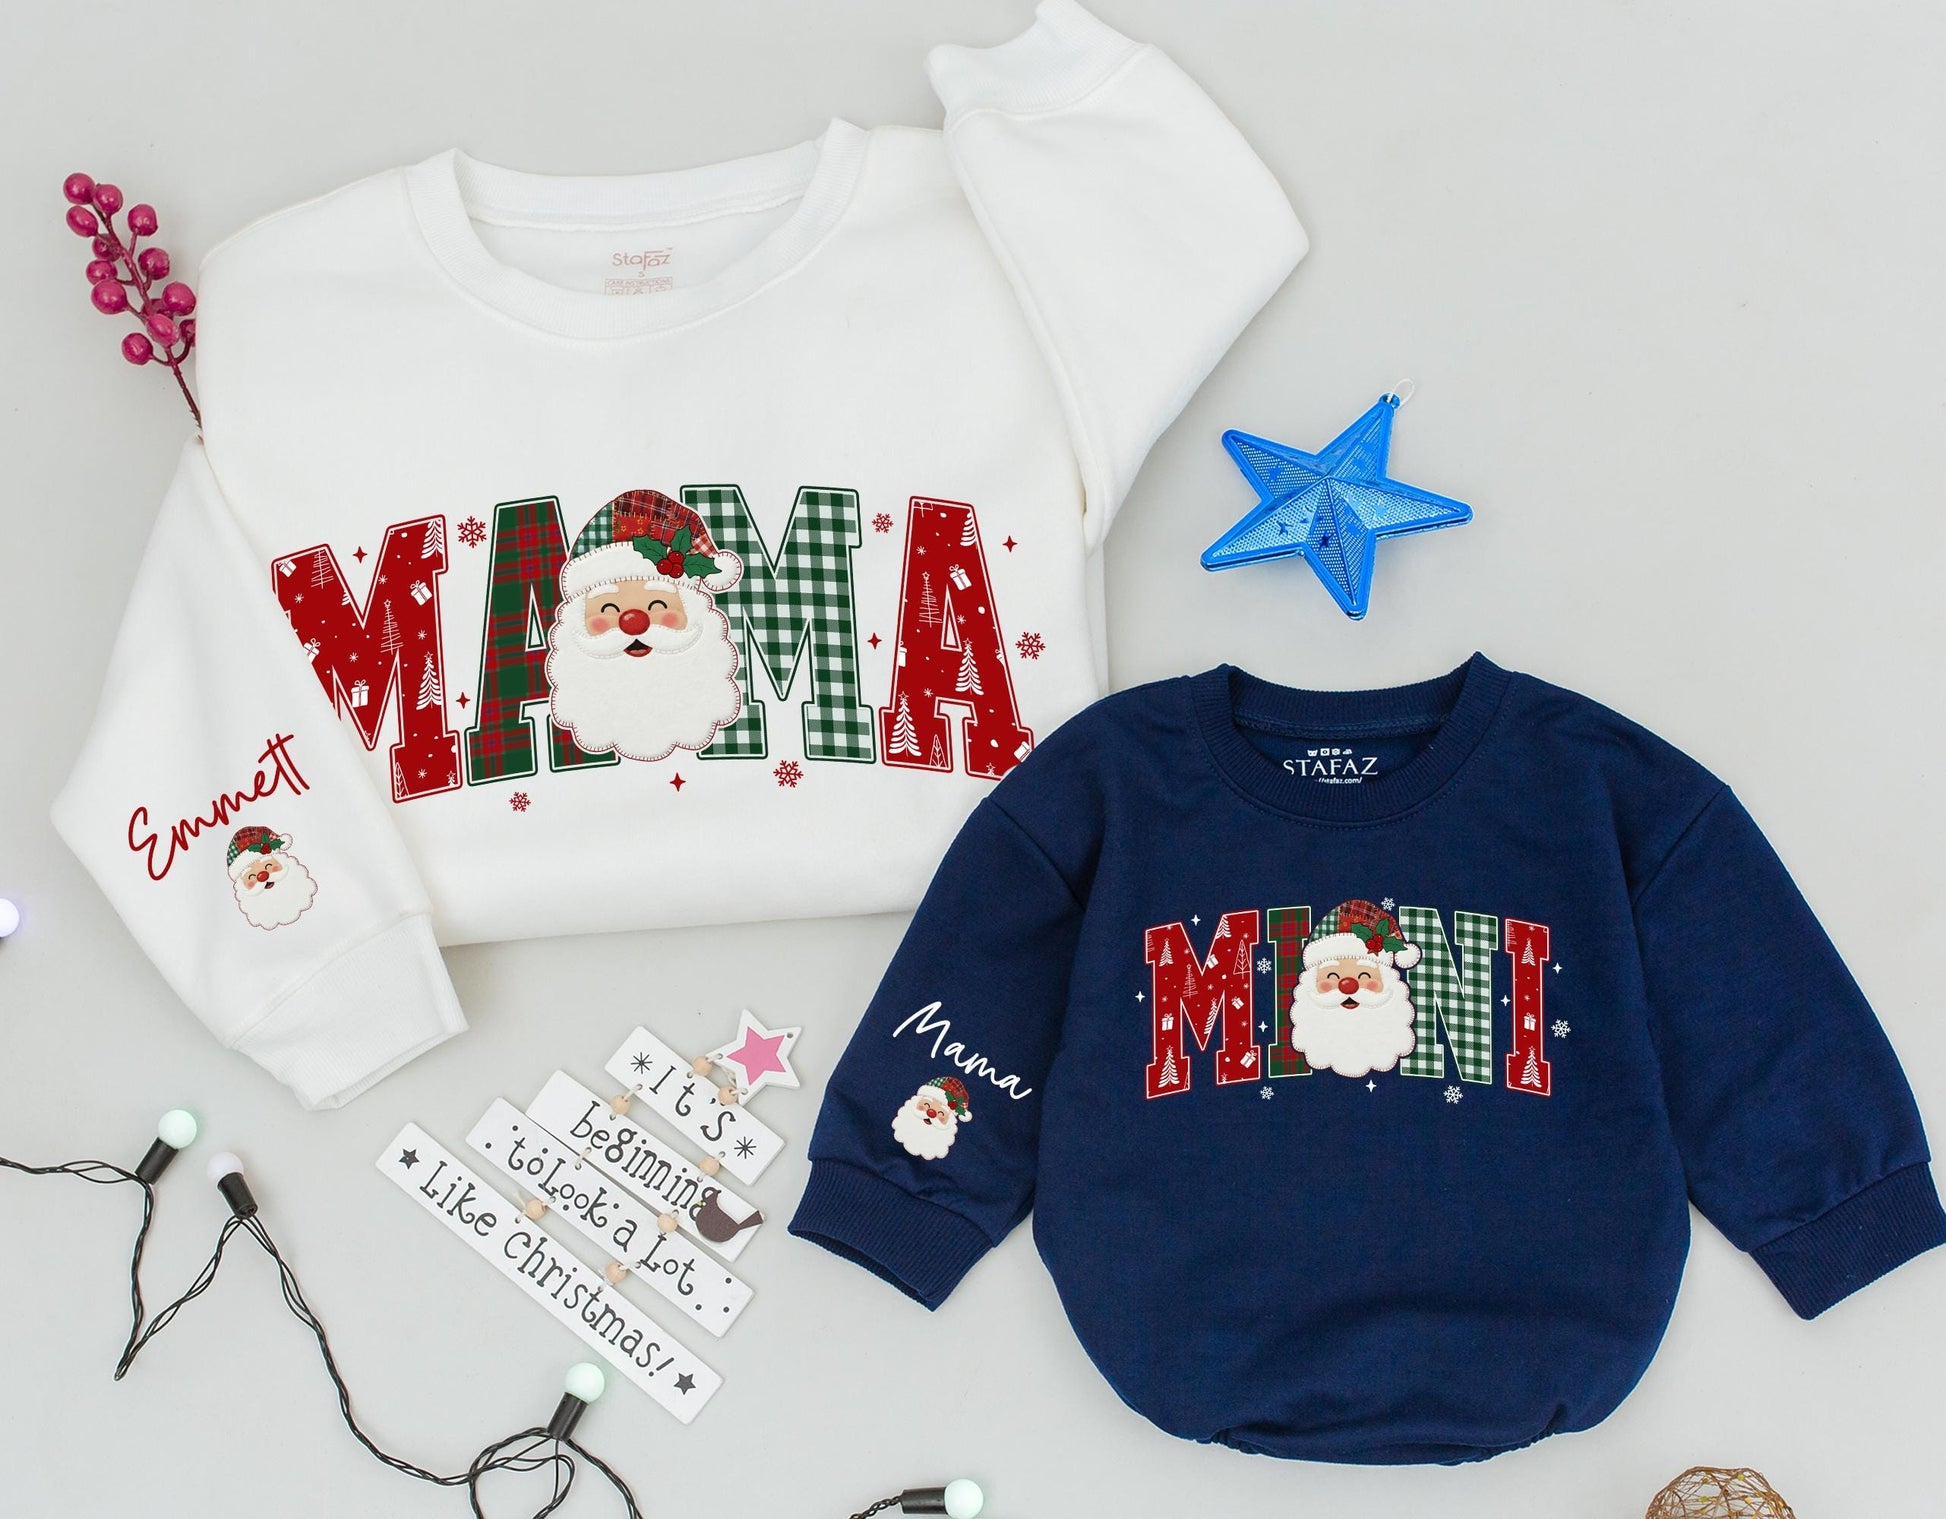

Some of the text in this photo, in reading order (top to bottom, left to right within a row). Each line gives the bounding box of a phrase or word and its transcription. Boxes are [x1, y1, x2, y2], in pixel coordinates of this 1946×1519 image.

[271, 484, 1035, 802] MAMA
[128, 733, 310, 881] Emmett
[1283, 757, 1379, 776] STAFAZ
[892, 1001, 1033, 1100] Mama
[1144, 905, 1551, 1099] MINI
[419, 1160, 498, 1237] Like
[537, 1158, 608, 1228] Look
[613, 1219, 638, 1253] a
